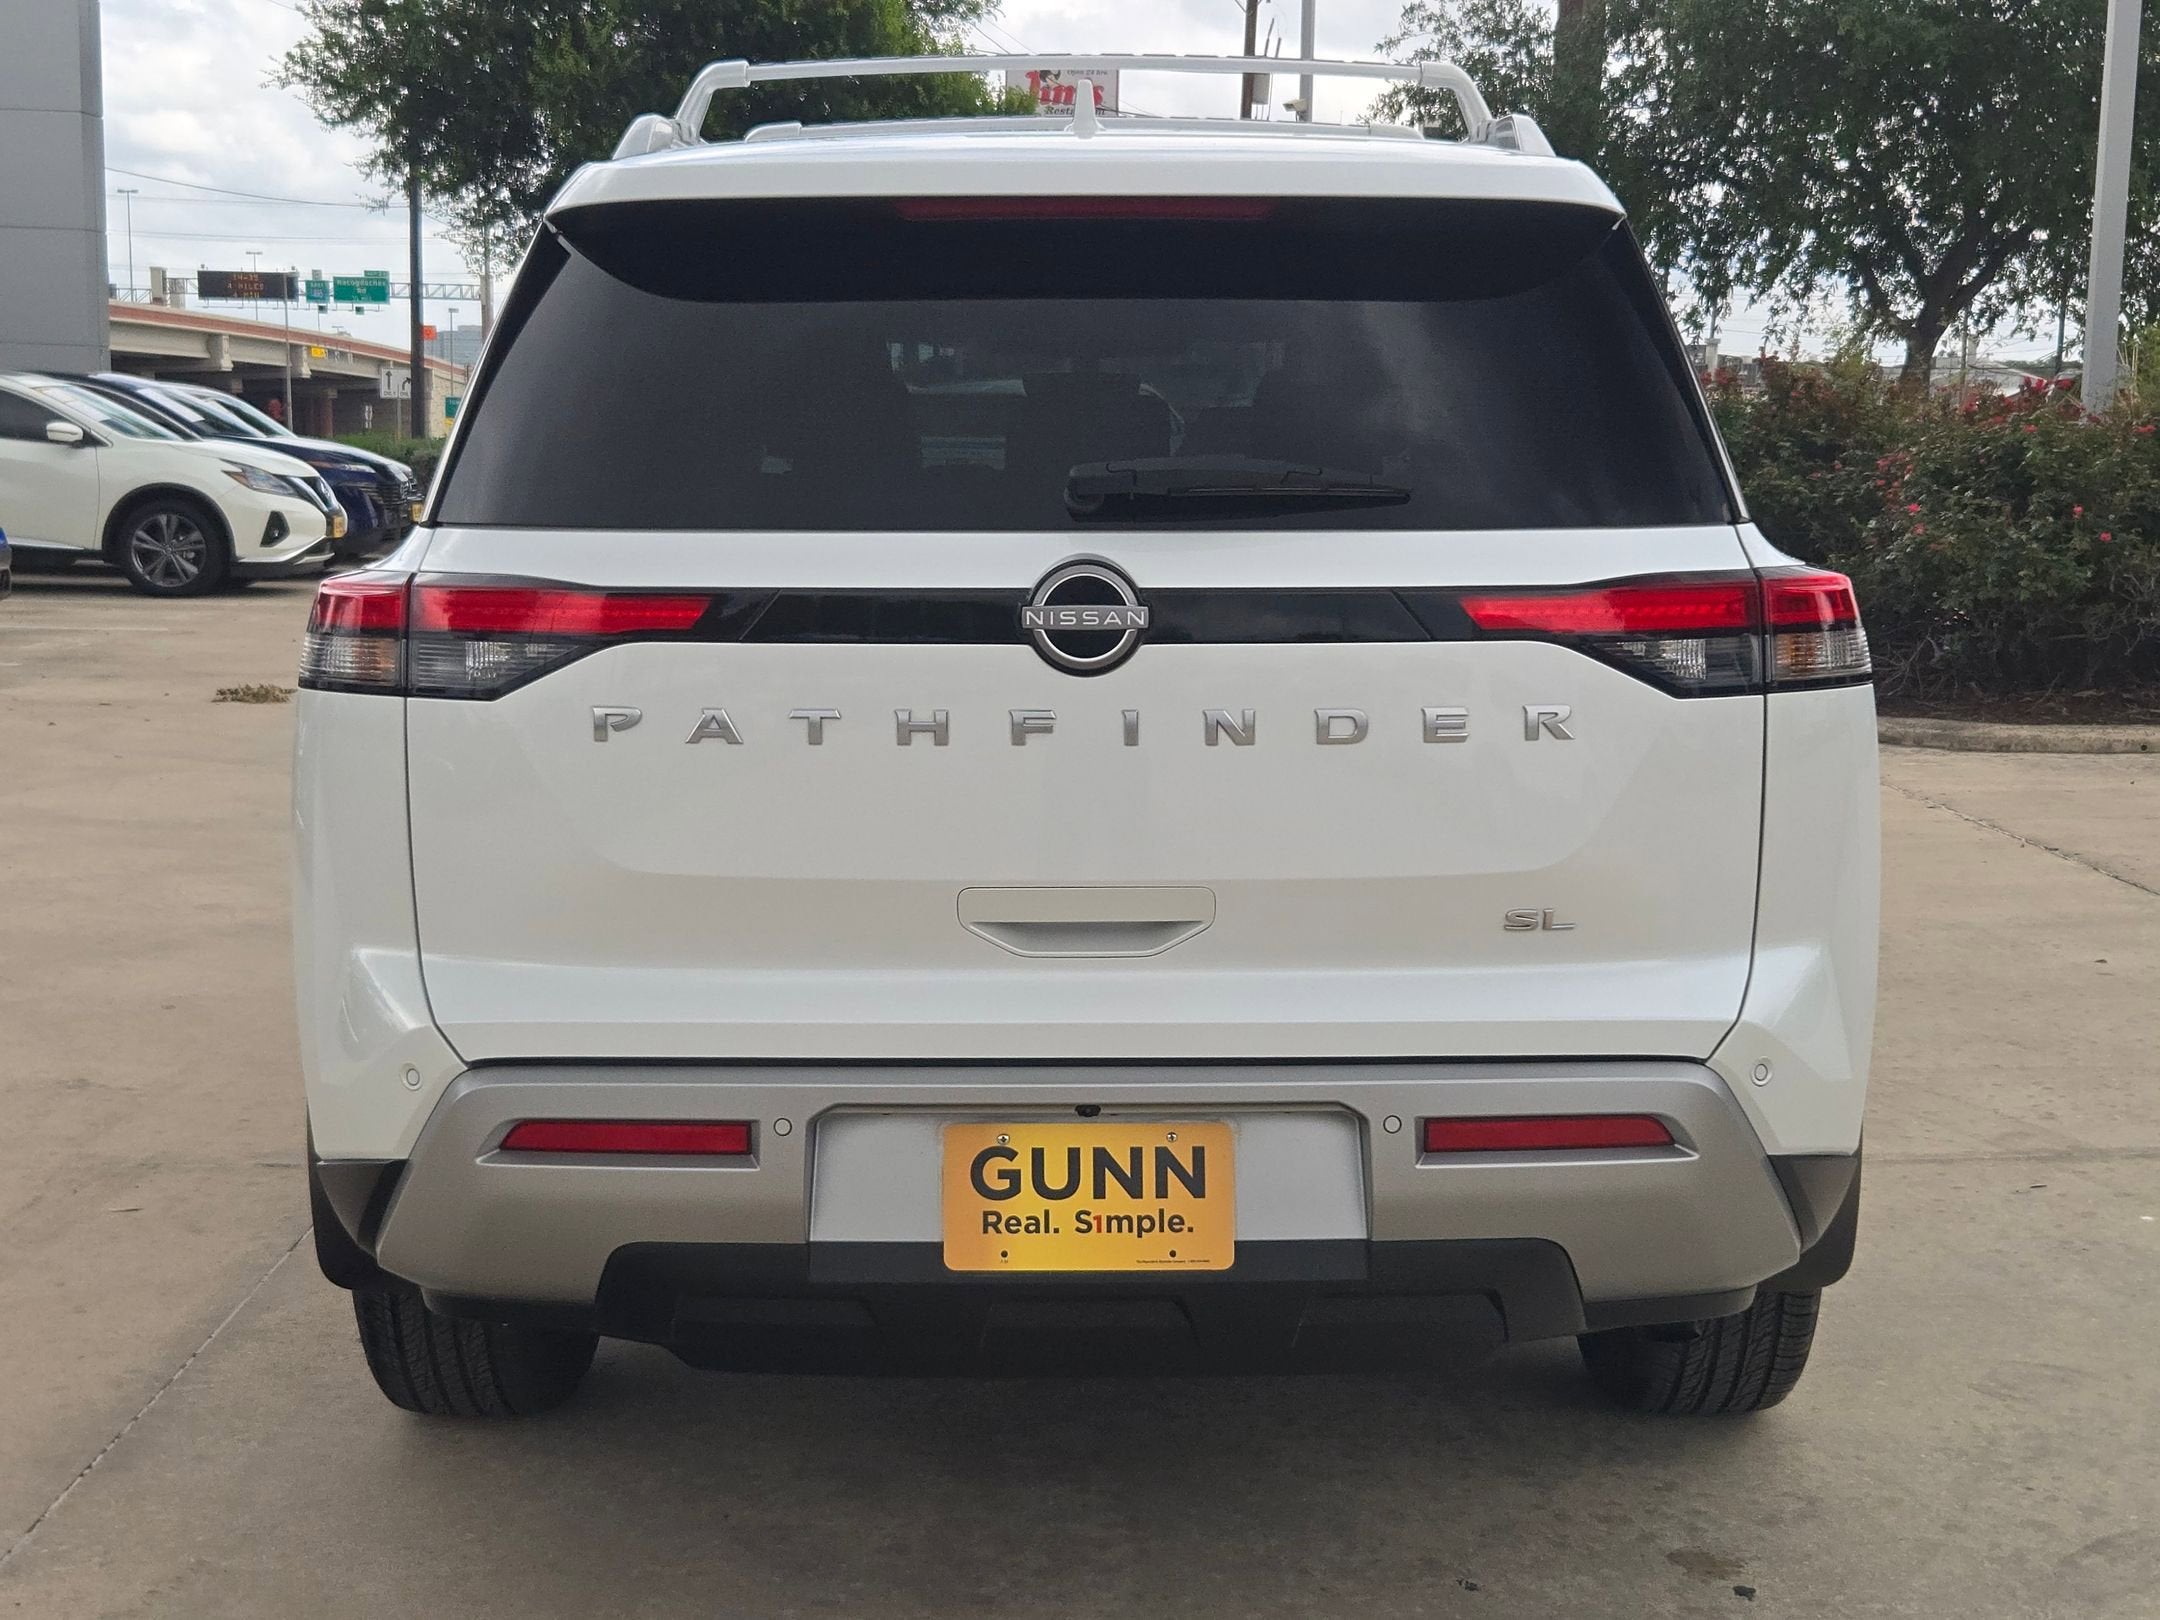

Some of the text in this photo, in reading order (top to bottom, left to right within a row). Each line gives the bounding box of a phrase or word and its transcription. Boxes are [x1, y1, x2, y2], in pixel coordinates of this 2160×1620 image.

[1026, 611, 1144, 625] NISSAN
[592, 704, 1575, 746] PATHFINDER
[1504, 908, 1576, 930] SL
[970, 1145, 1206, 1200] GUNN
[982, 1209, 1060, 1234] Real.
